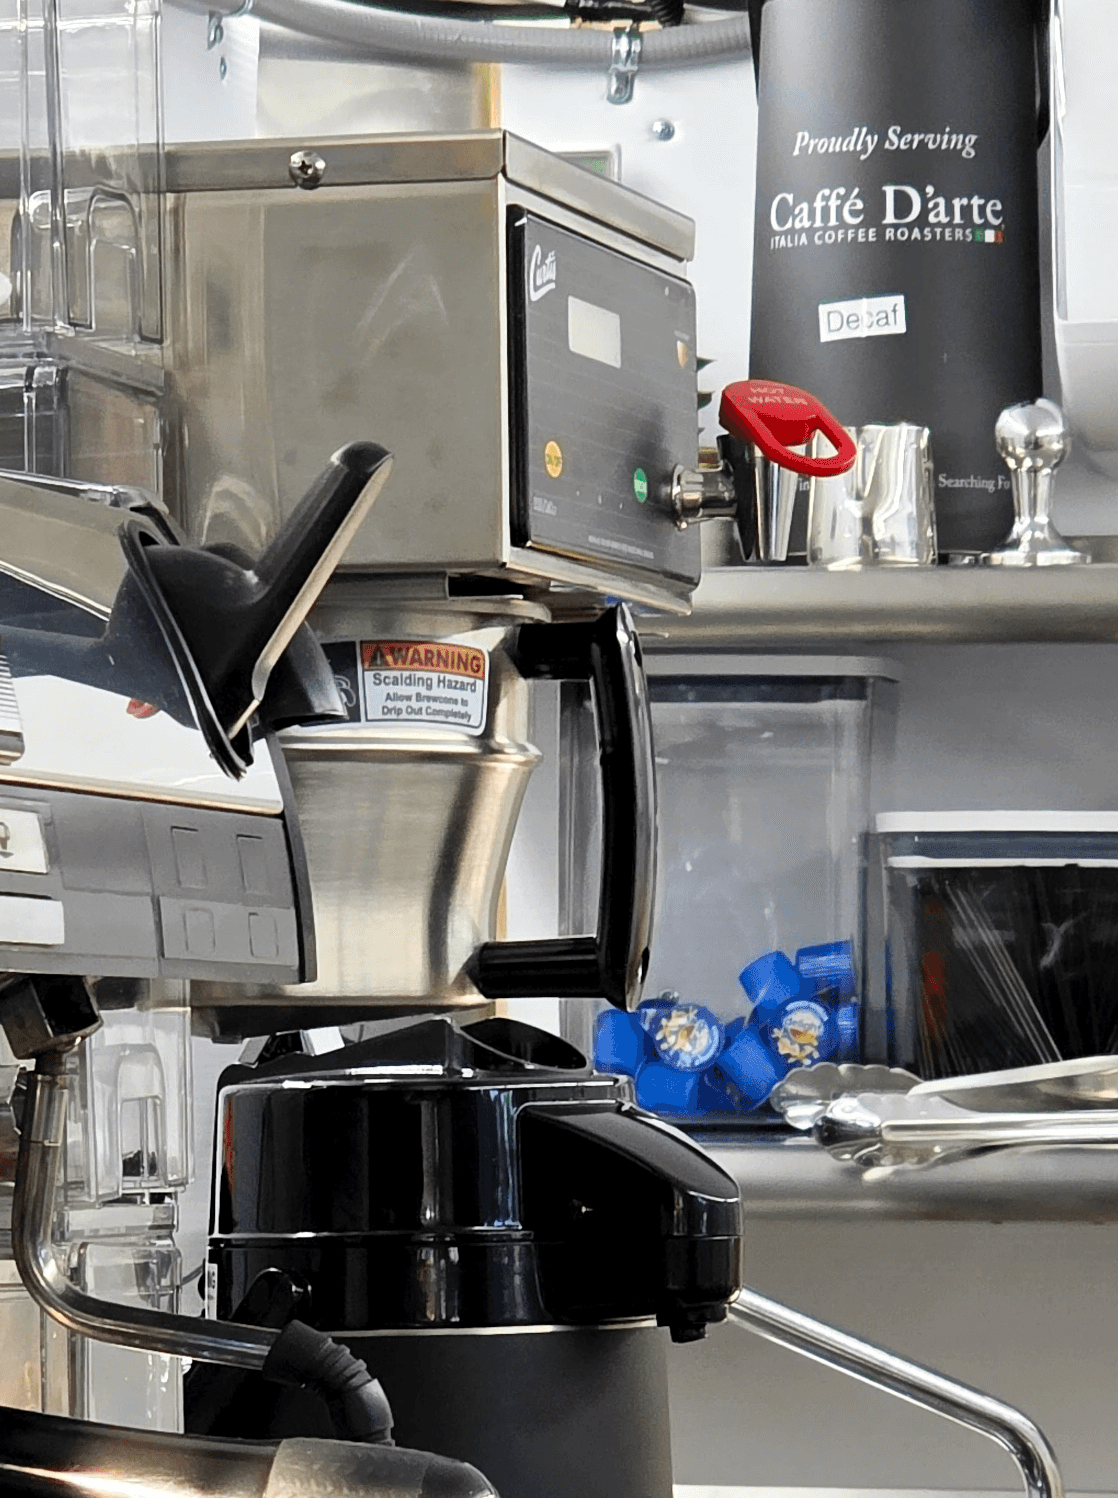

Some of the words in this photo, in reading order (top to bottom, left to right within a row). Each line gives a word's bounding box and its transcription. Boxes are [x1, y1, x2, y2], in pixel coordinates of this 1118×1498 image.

[793, 126, 878, 160] Proudly
[884, 125, 978, 159] Serving
[770, 187, 864, 231] Caffé
[882, 184, 1004, 226] D'arte
[770, 232, 808, 250] ITALIA
[814, 227, 877, 244] COFFEE
[885, 226, 973, 242] ROASTERS
[826, 303, 900, 334] Decaf
[938, 473, 995, 493] Searching
[998, 474, 1010, 490] Fo
[389, 646, 482, 674] WARNING
[373, 672, 433, 691] Scalding
[437, 674, 477, 693] Hazard
[385, 692, 413, 702] Allow
[461, 697, 469, 707] to
[382, 706, 404, 717] Drip
[406, 706, 423, 716] Out
[425, 706, 472, 722] Completely
